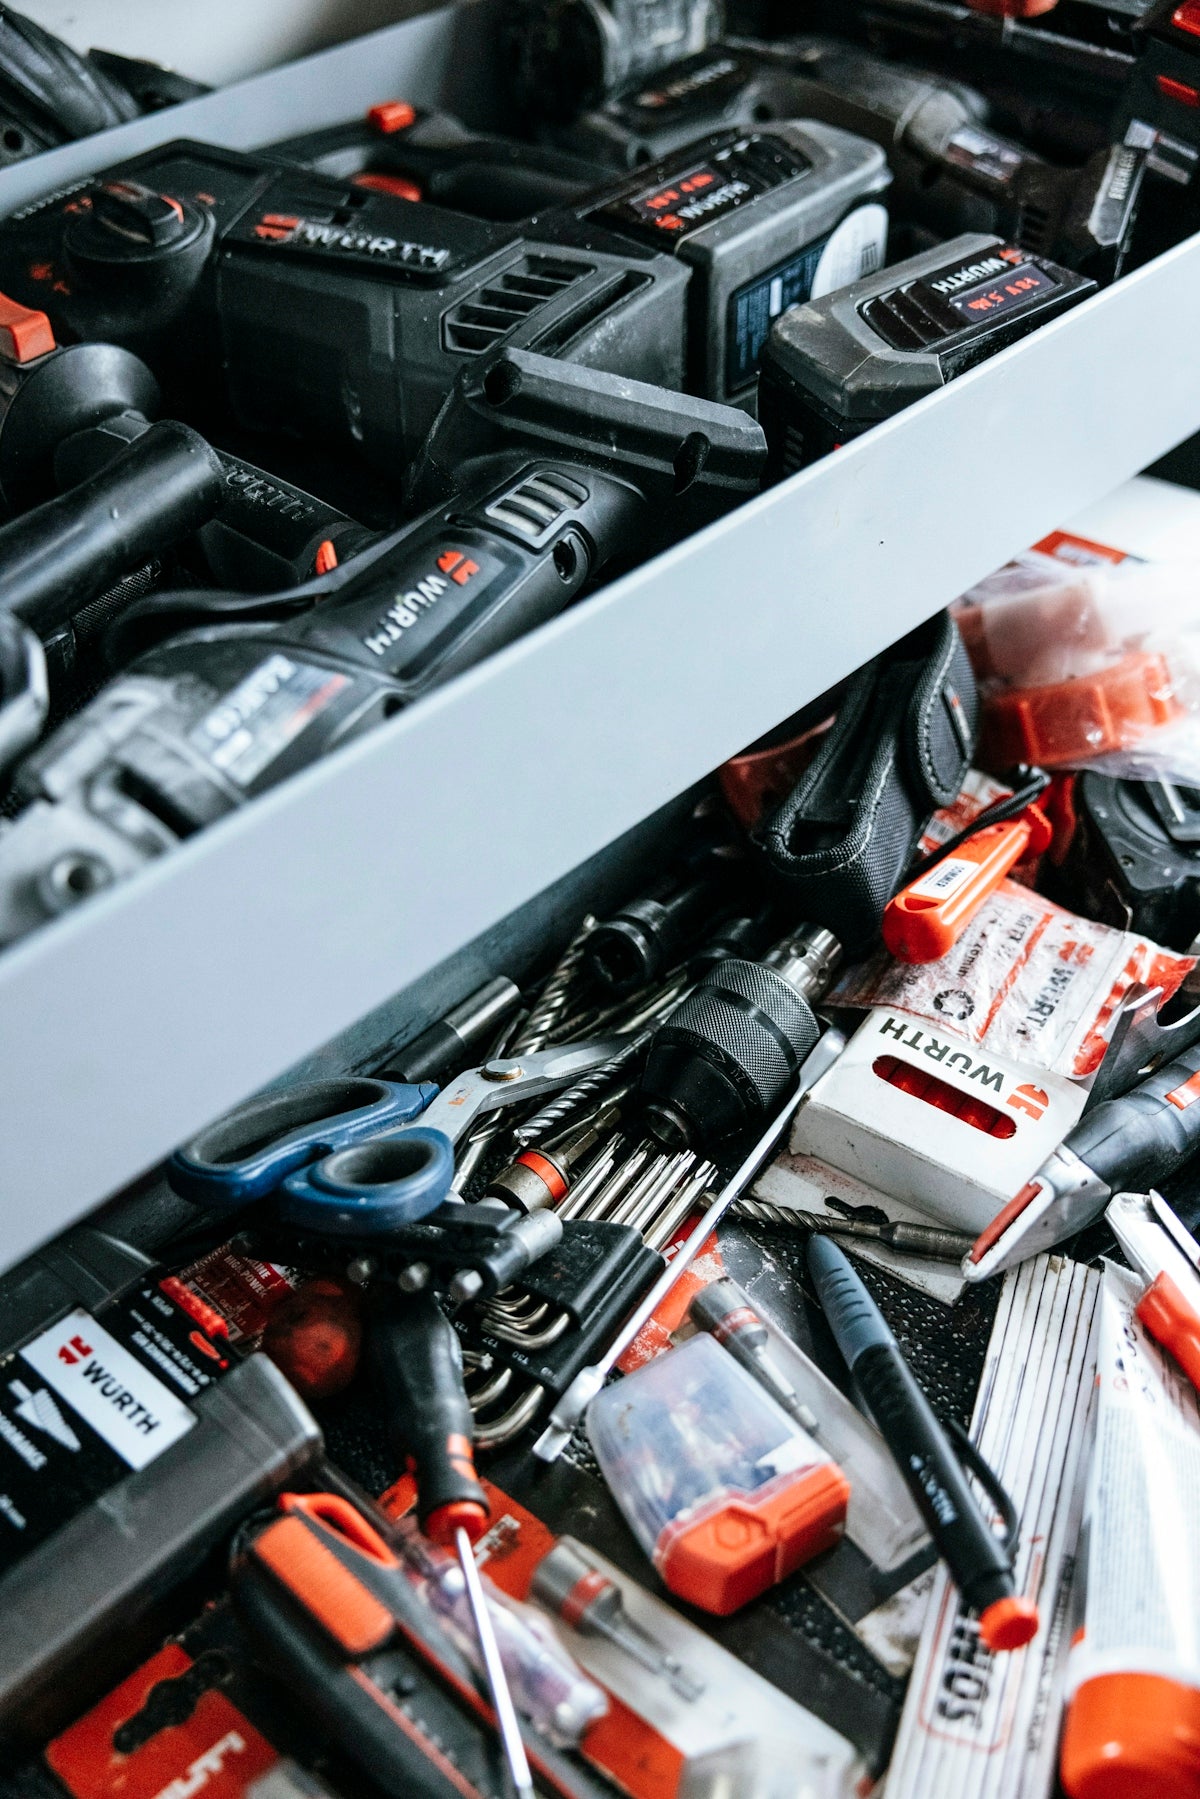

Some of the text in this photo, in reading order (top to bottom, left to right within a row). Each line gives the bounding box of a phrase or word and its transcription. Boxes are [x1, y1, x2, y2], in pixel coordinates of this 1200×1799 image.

[302, 222, 451, 269] WÜRTH
[224, 464, 315, 521] ÜRTH
[365, 573, 449, 658] WÜRTH
[878, 1016, 1005, 1093] WÜRTH
[82, 1359, 162, 1439] WÜRTH
